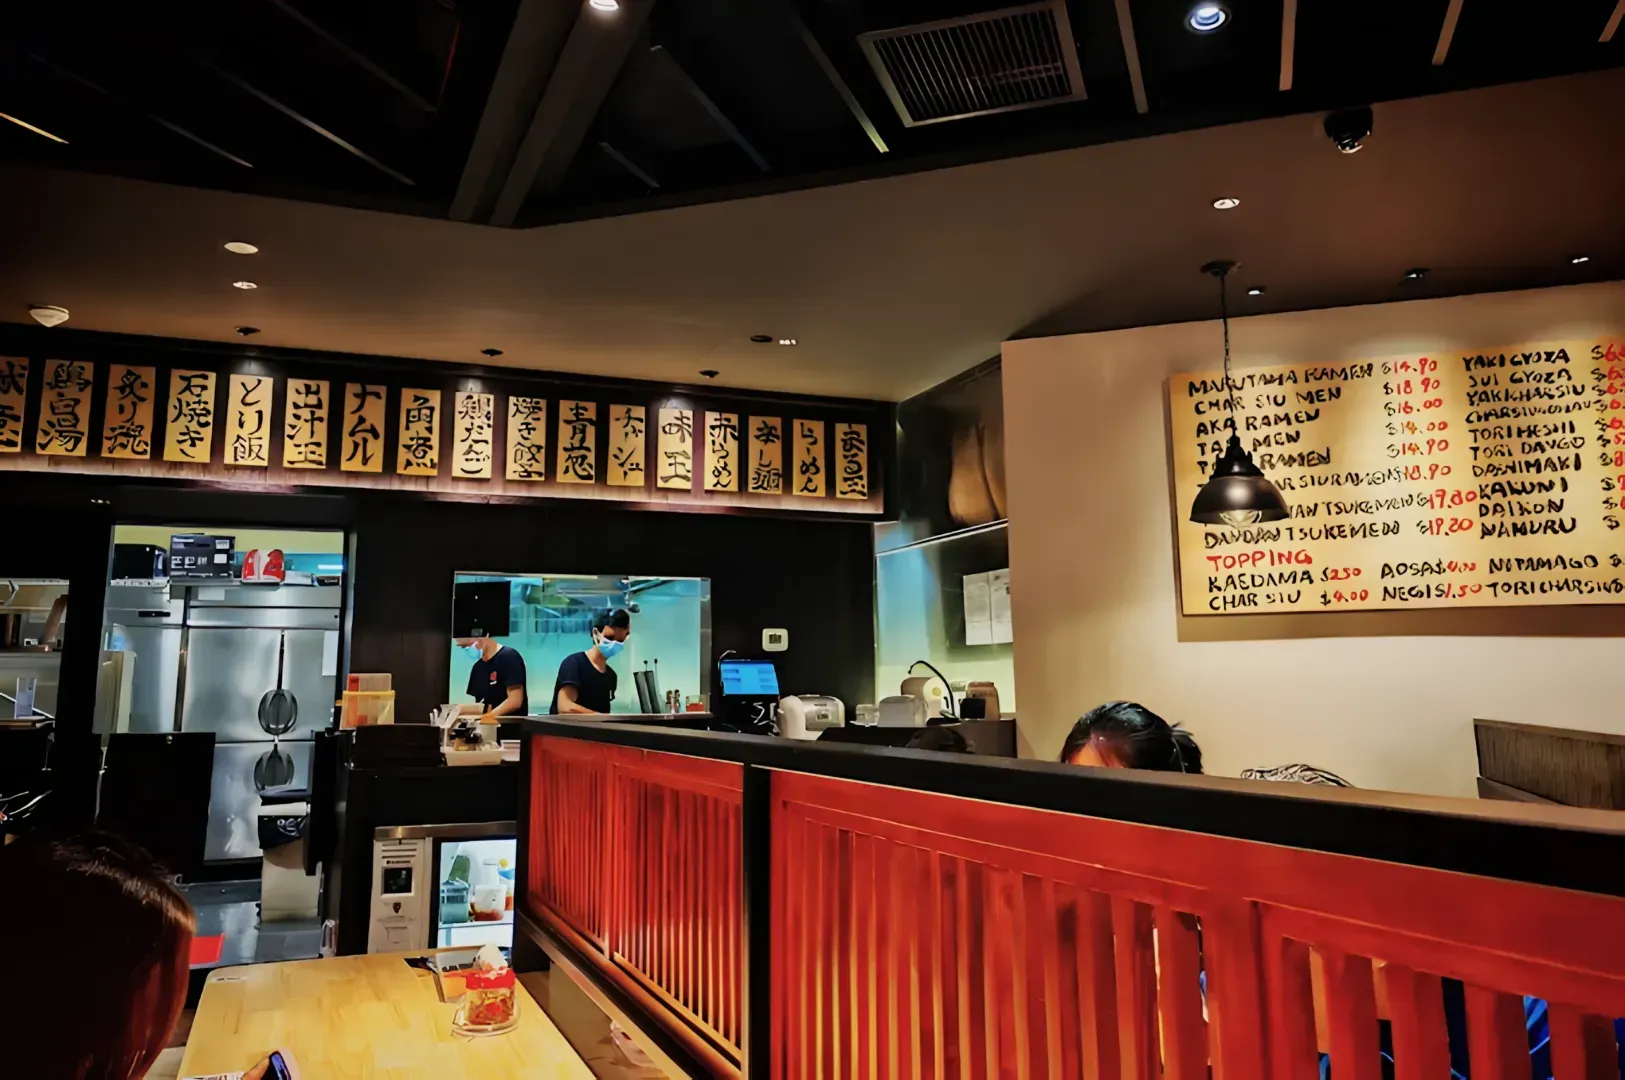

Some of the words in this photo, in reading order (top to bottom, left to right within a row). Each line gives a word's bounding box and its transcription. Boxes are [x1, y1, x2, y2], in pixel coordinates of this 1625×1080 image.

[1462, 353, 1506, 371] YAKI
[1509, 368, 1573, 384] GYOZA
[1255, 394, 1286, 409] SIU
[1296, 386, 1341, 404] MEN
[171, 373, 211, 459] 石焼き
[231, 378, 266, 462] とり飯
[345, 382, 383, 466] ナムル
[1245, 408, 1320, 431] RAMEN
[1384, 398, 1443, 416] $16.00
[660, 409, 693, 484] 味玉
[1252, 430, 1301, 451] MEN
[1206, 549, 1313, 572] TOPPING
[1208, 570, 1314, 593] KAEDAMA
[1382, 584, 1431, 602] NEGI
[1209, 592, 1259, 611] CHAR
[1265, 590, 1301, 604] SIU
